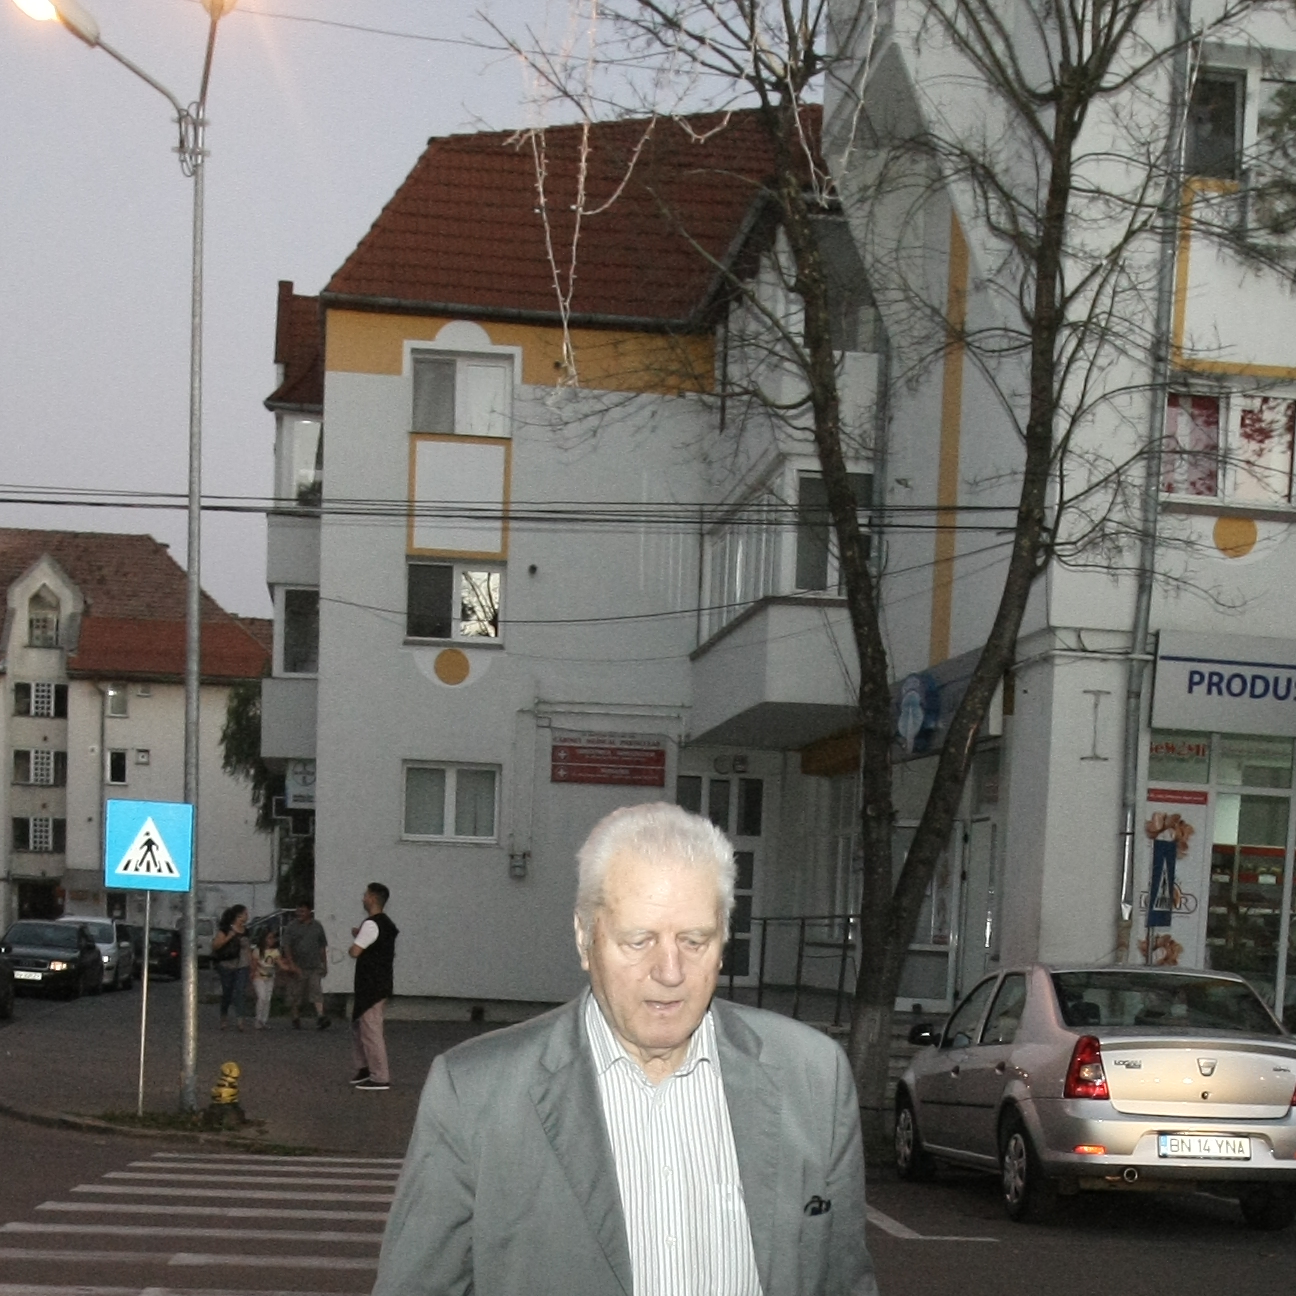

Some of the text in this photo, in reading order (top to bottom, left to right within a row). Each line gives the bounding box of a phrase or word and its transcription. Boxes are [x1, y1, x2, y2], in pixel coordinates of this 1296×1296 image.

[1170, 1138, 1245, 1154] BN 14 YNA
